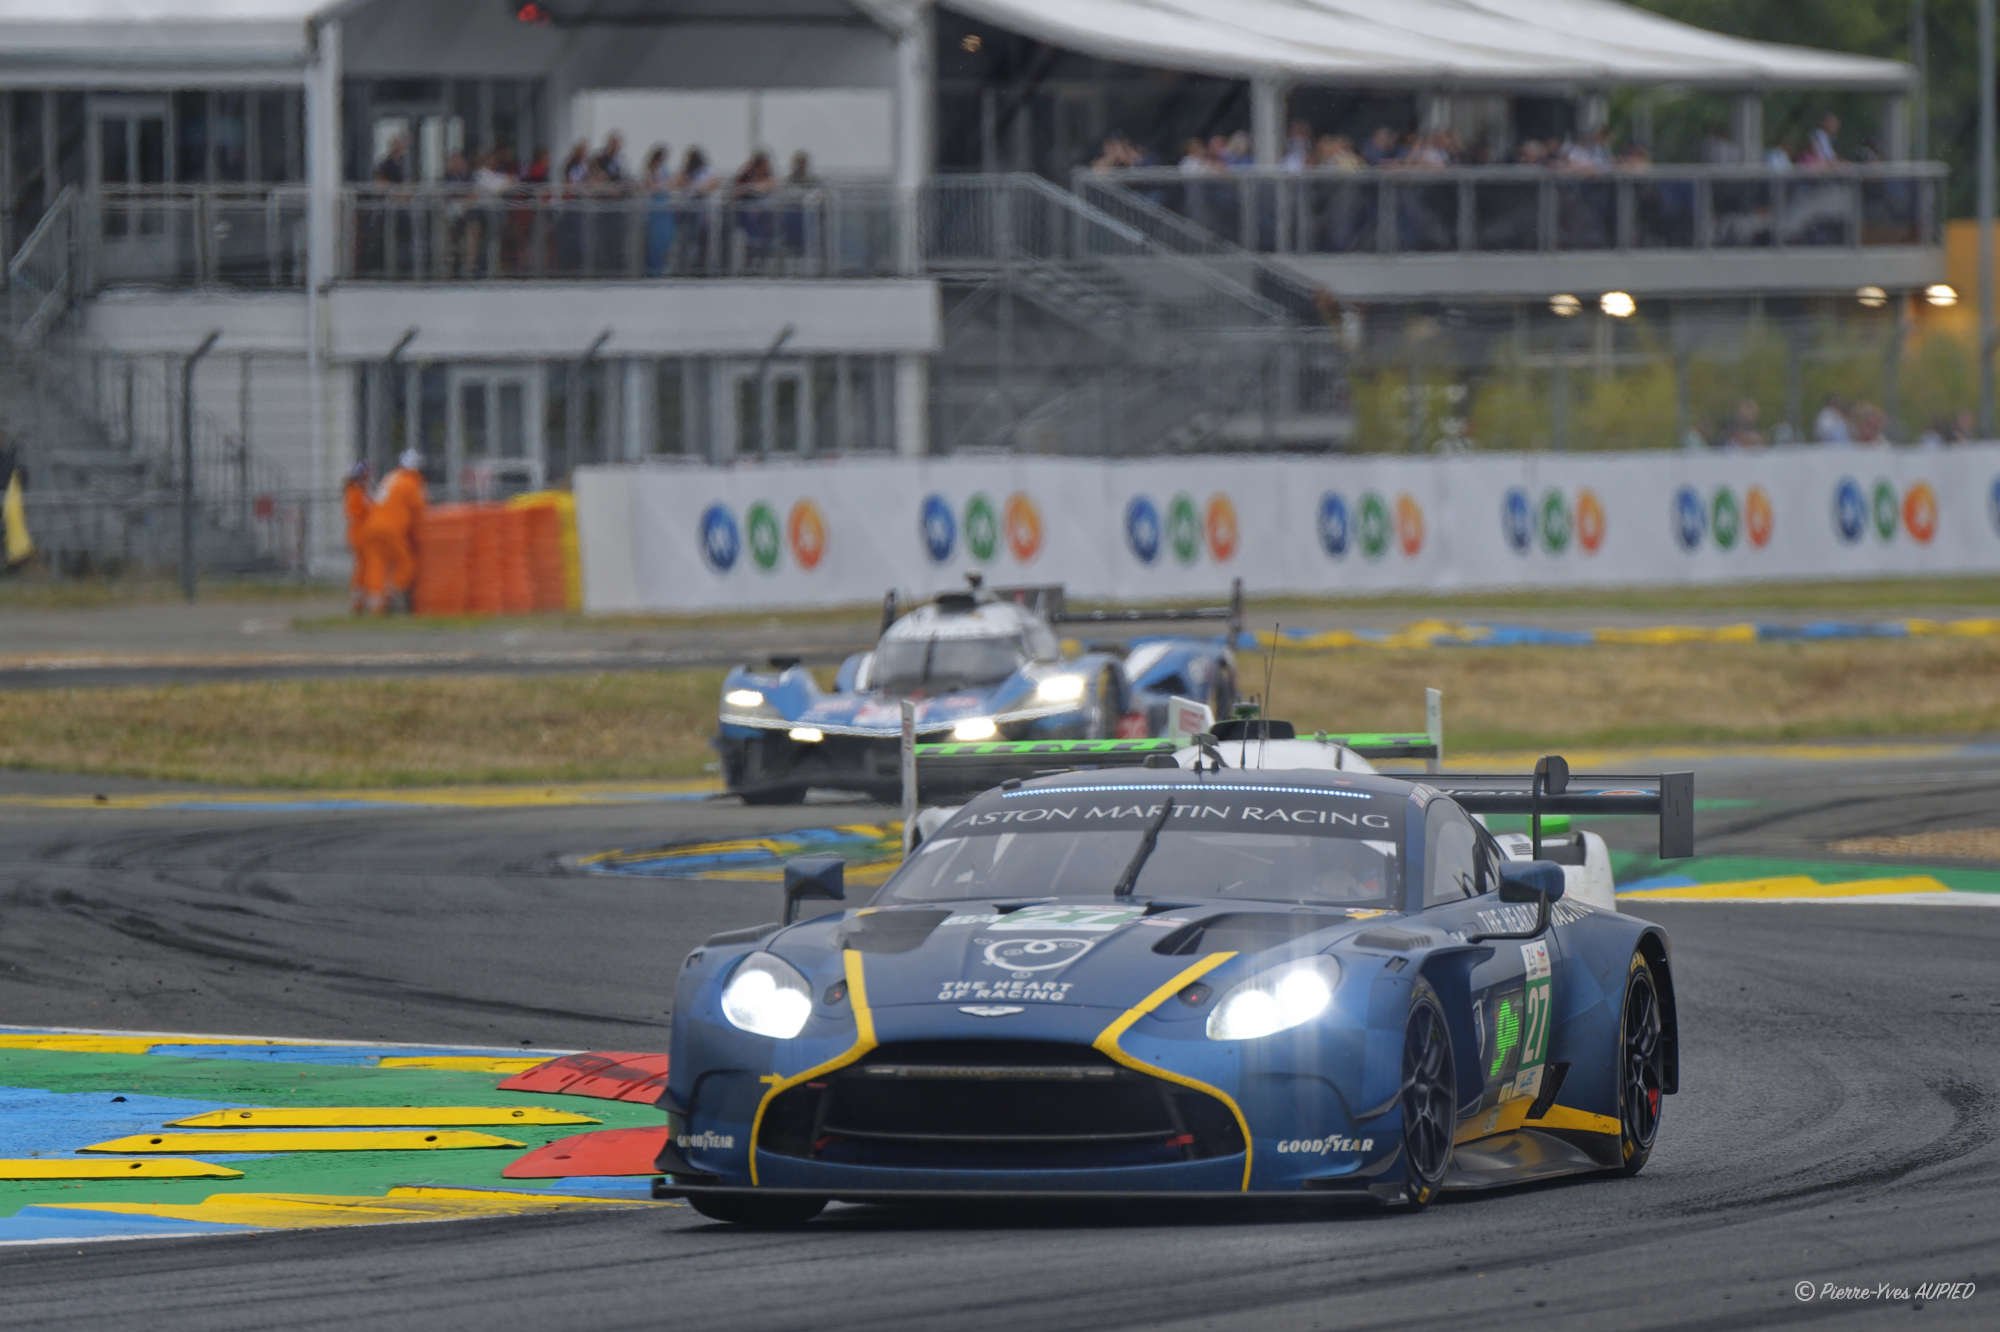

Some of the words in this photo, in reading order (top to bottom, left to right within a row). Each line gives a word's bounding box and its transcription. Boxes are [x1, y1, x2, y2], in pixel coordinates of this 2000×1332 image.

[952, 807, 1078, 829] ASTON
[1084, 804, 1231, 819] MARTIN
[1241, 806, 1390, 829] RACING
[1020, 909, 1127, 925] 27
[937, 990, 969, 1000] OF
[975, 989, 1065, 1001] RACING
[942, 981, 987, 991] THE
[993, 980, 1073, 992] HEART
[1521, 983, 1550, 1065] 27
[1277, 1134, 1375, 1156] GOODYEAR
